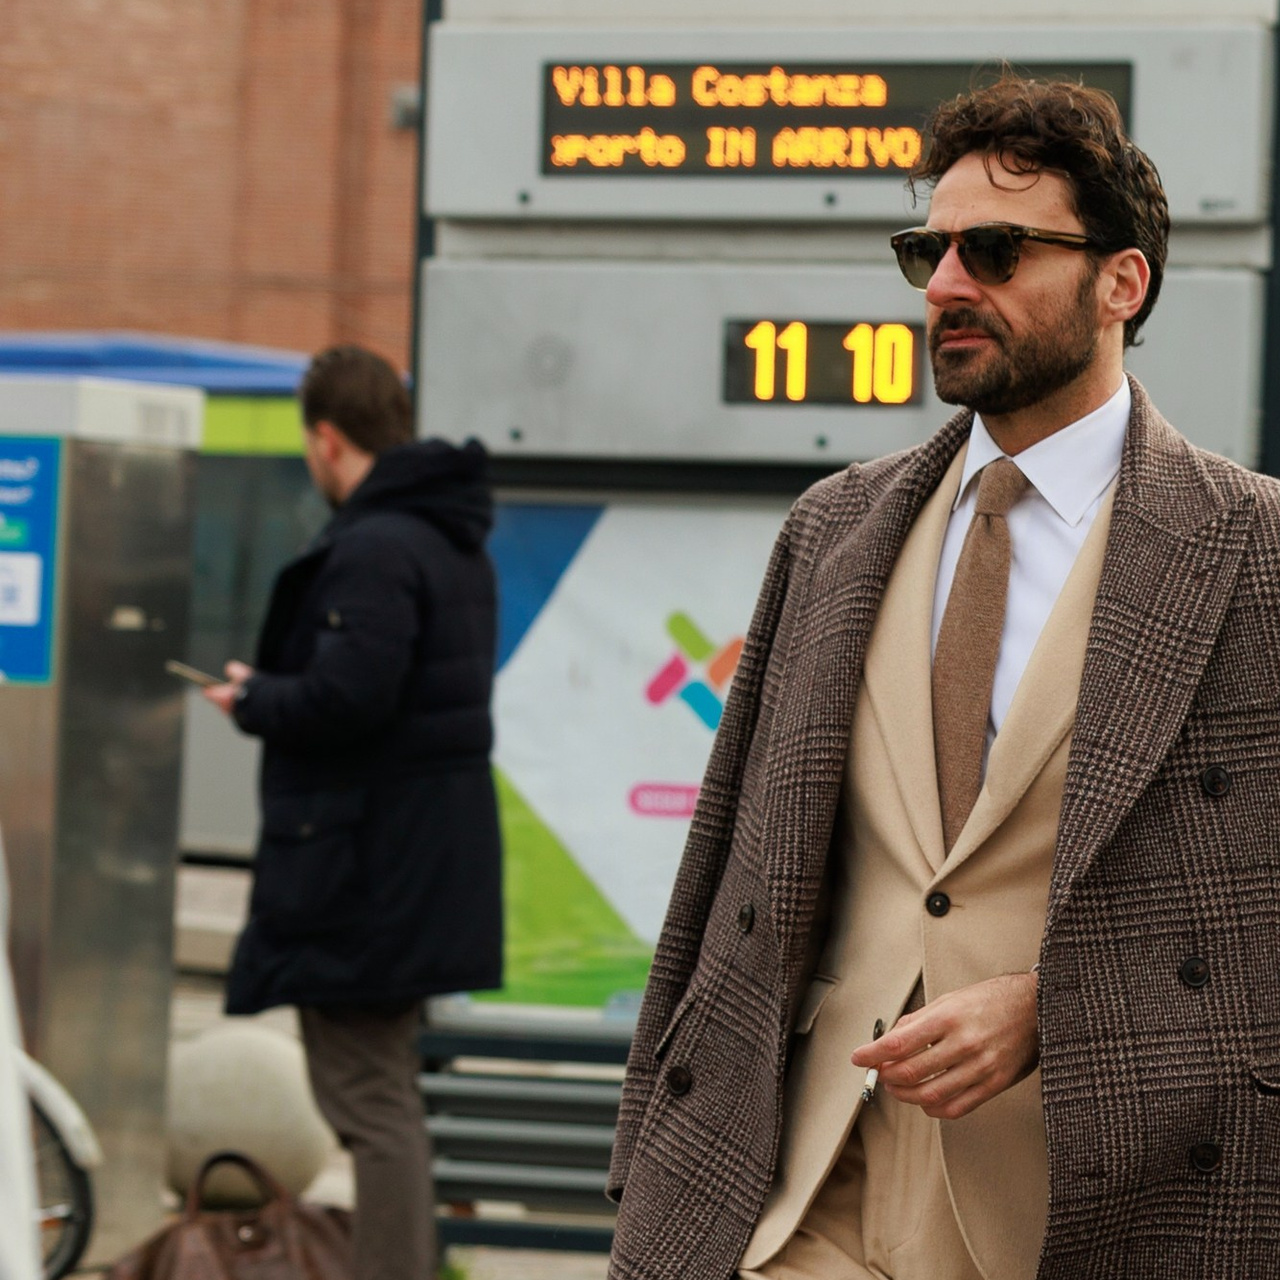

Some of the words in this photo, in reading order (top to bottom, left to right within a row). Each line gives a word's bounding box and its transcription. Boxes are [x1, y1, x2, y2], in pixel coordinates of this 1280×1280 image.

[552, 65, 677, 108] Villa
[691, 65, 888, 108] Costanza
[705, 126, 757, 168] IN
[771, 126, 921, 169] ARRIVO
[745, 320, 808, 402] 11
[842, 322, 914, 404] 10
